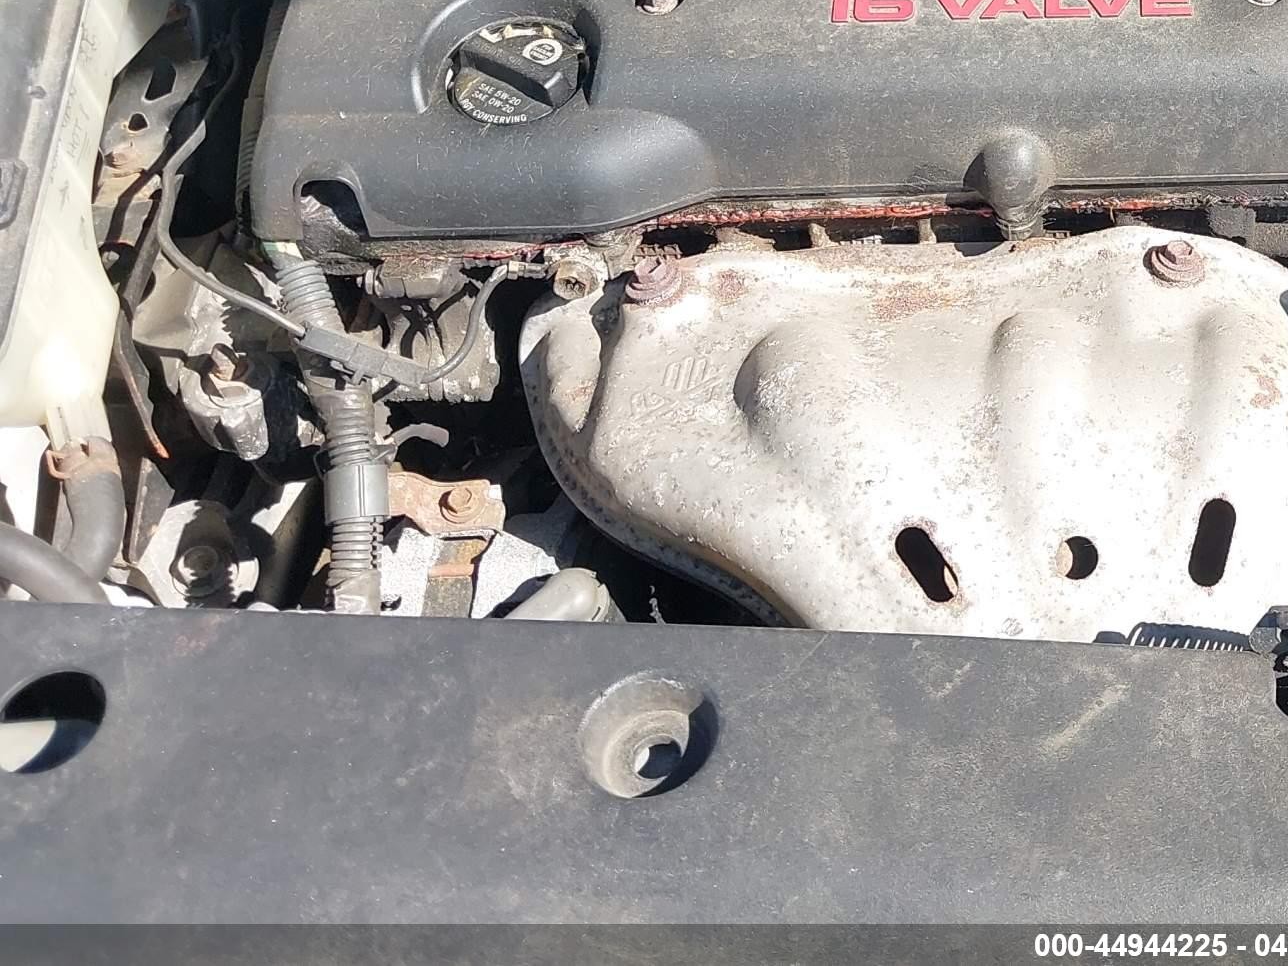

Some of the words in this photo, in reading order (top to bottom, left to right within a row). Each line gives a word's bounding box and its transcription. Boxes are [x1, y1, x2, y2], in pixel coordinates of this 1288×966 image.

[471, 90, 489, 102] SAE
[479, 83, 496, 94] SAE
[495, 90, 521, 106] 5W-20
[473, 109, 527, 123] CONSERVING
